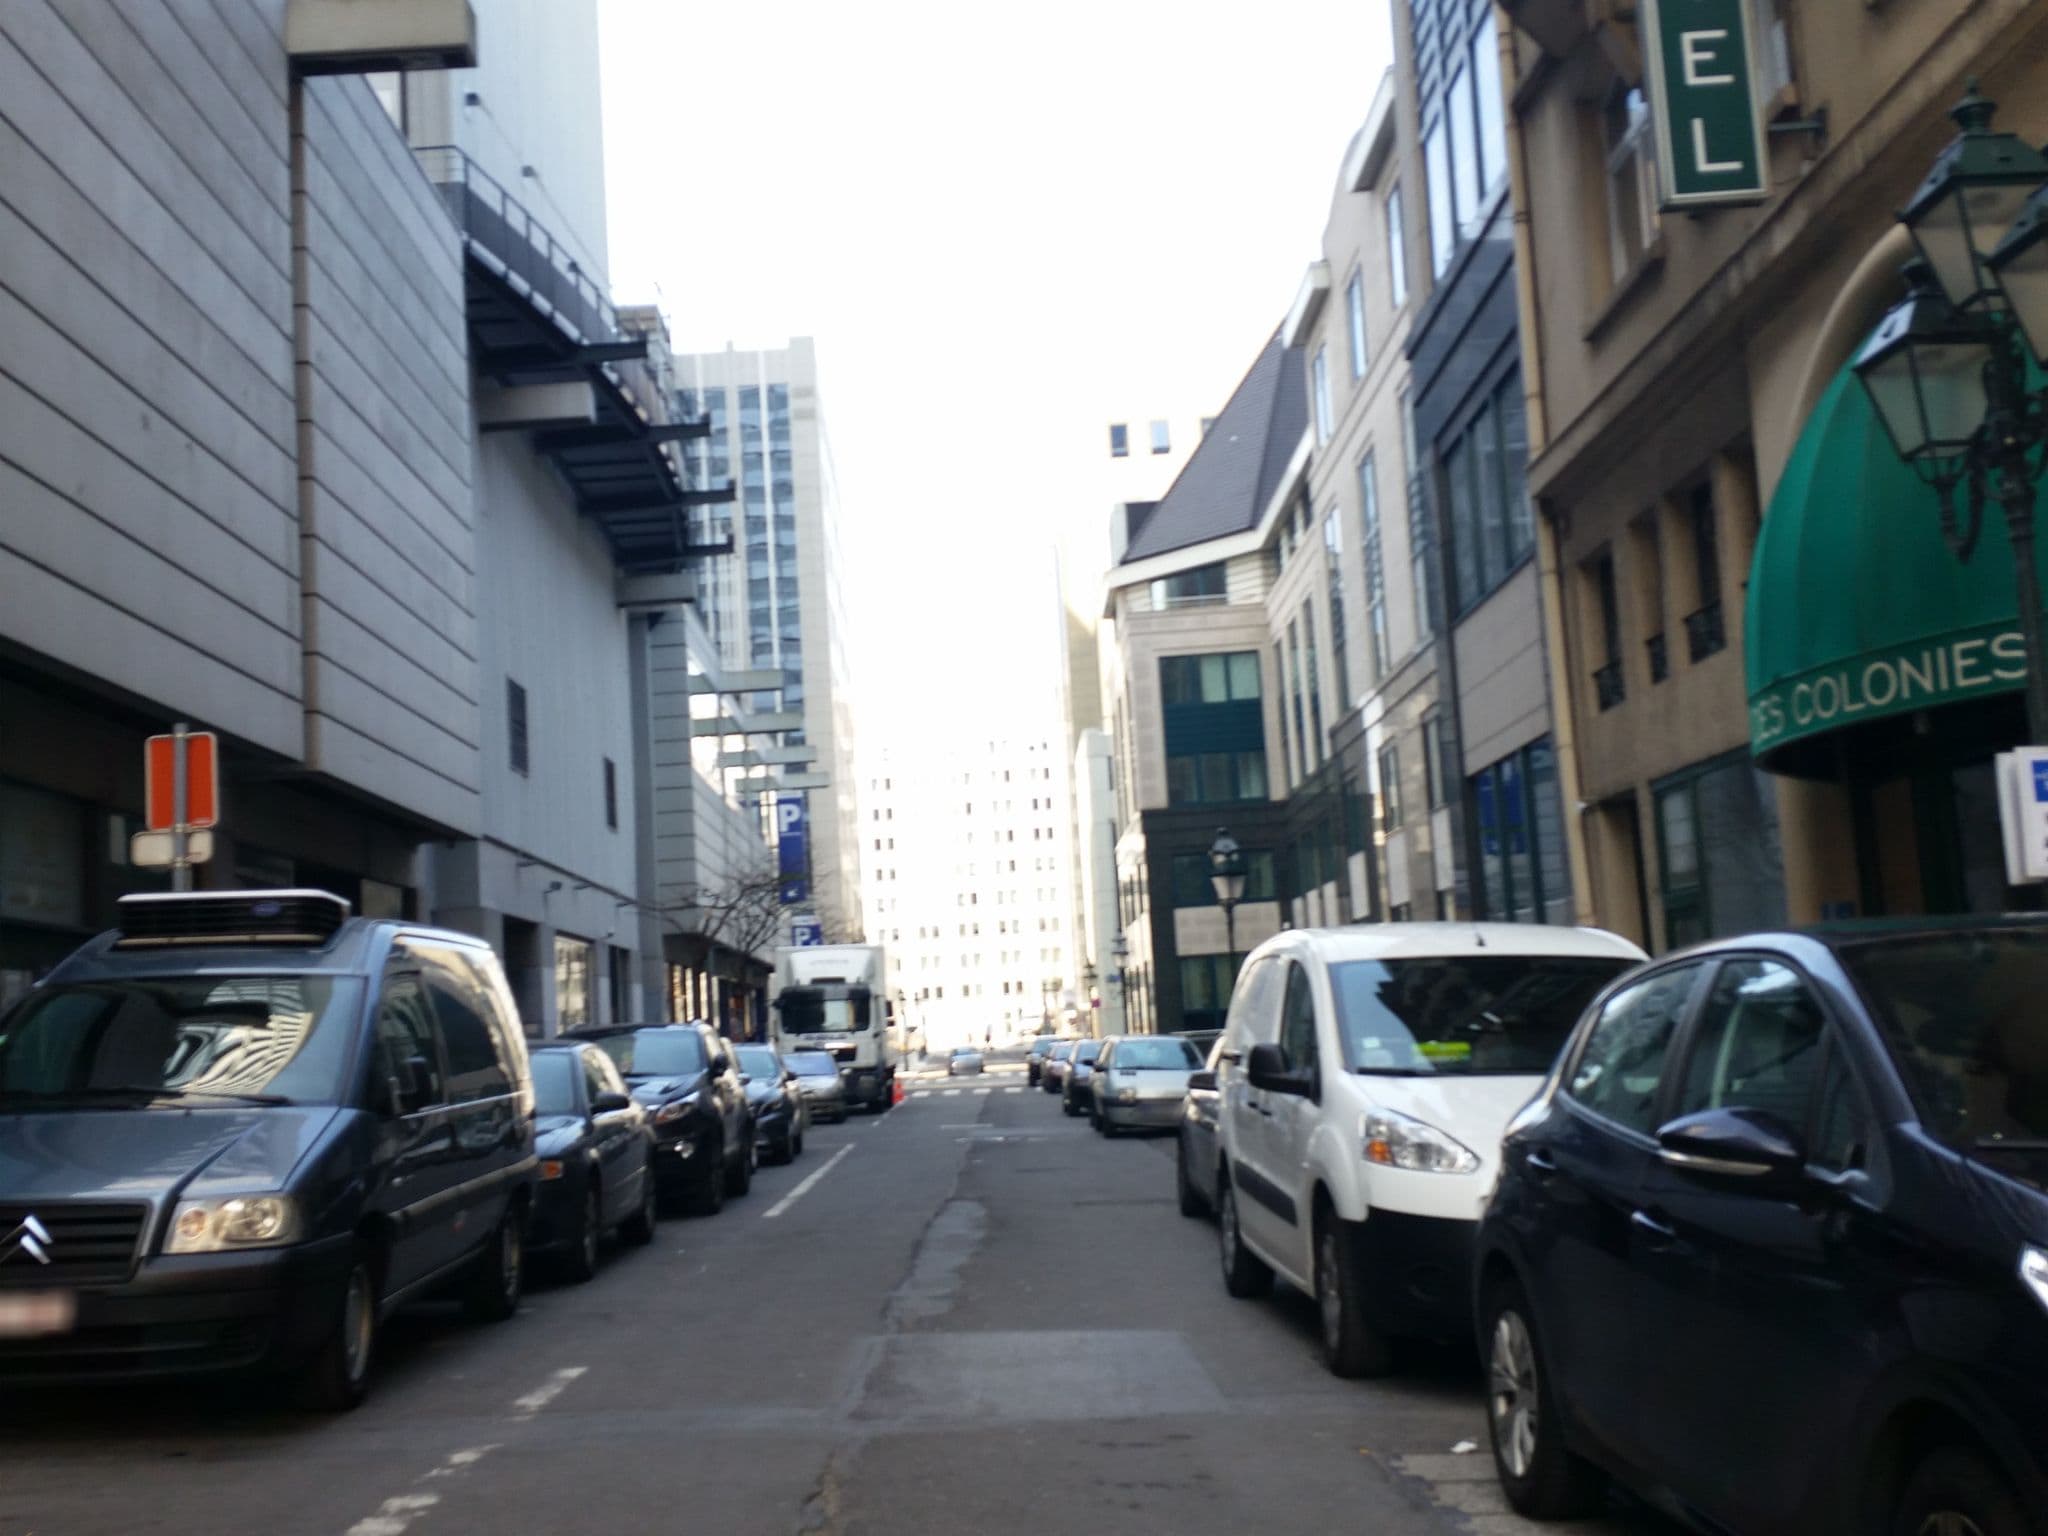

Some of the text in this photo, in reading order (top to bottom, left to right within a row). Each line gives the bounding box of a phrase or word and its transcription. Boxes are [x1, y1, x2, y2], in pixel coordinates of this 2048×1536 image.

[1792, 632, 2027, 725] COLONIES
[779, 803, 801, 833] P
[794, 927, 812, 946] P
